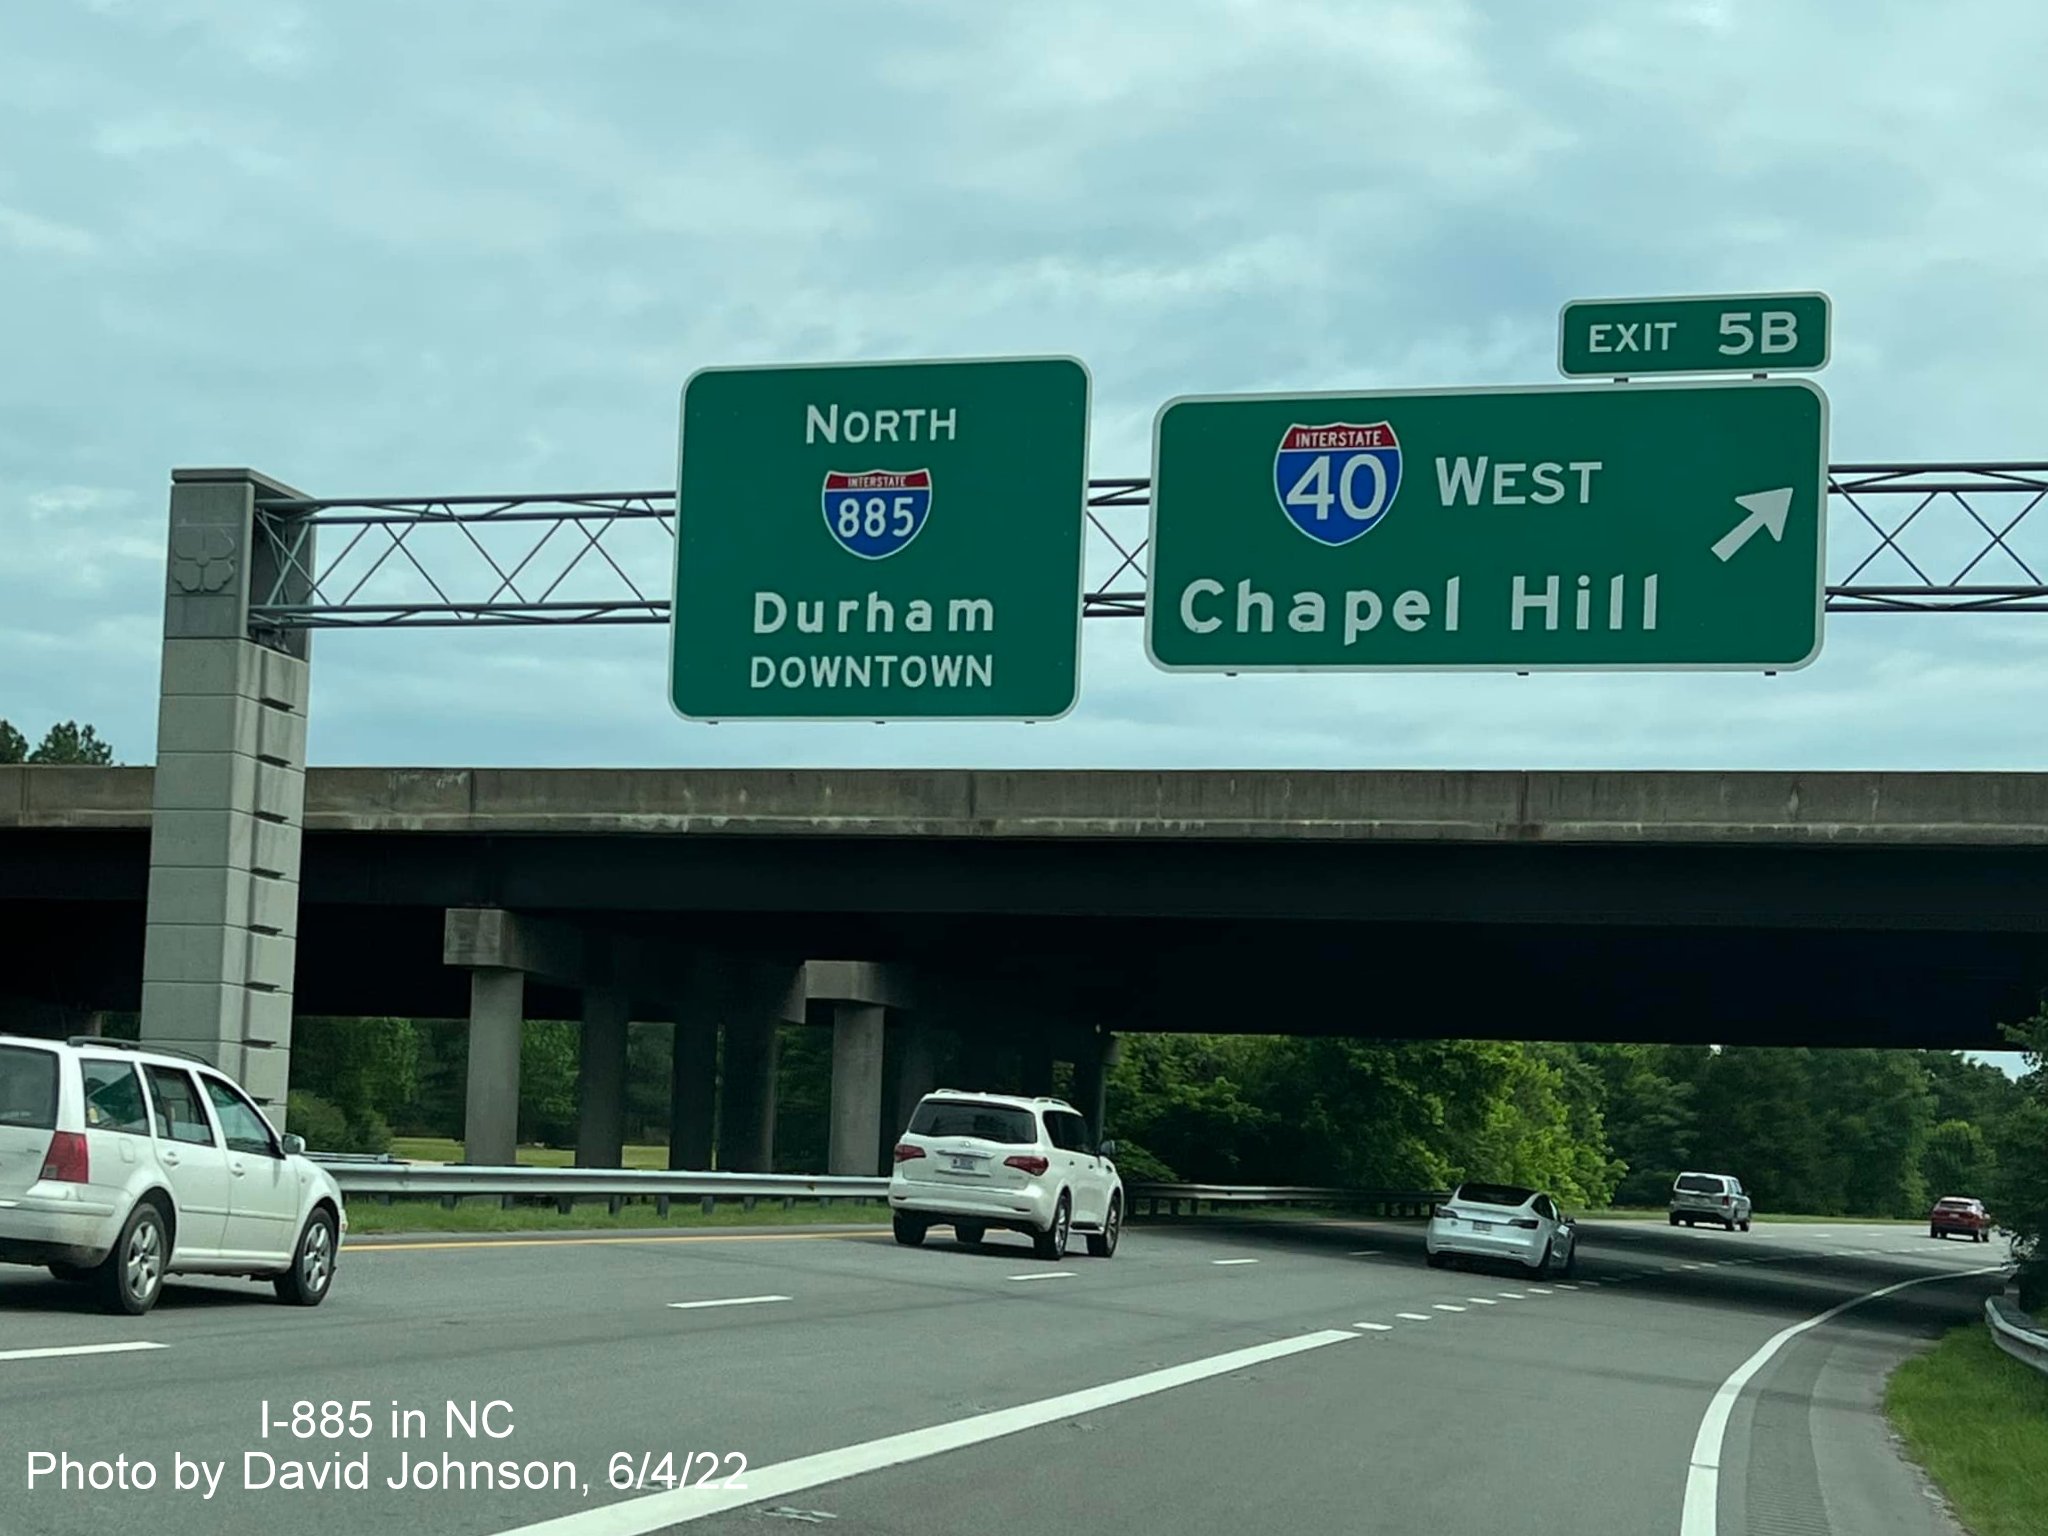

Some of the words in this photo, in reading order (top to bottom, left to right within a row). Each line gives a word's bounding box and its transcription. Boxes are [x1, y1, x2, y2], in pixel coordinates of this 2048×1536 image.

[1589, 322, 1677, 353] EXIT
[1718, 311, 1799, 355] 5B
[806, 404, 956, 444] NORTH
[1295, 430, 1382, 448] INTERSTATE
[847, 475, 907, 488] INTERSTATE
[1286, 453, 1387, 520] 40
[1435, 456, 1602, 506] WEST
[838, 497, 914, 538] 885
[753, 591, 994, 634] Durham
[1180, 576, 1460, 646] Chapel
[1511, 574, 1658, 630] Hill
[750, 654, 993, 688] DOWNTOWN
